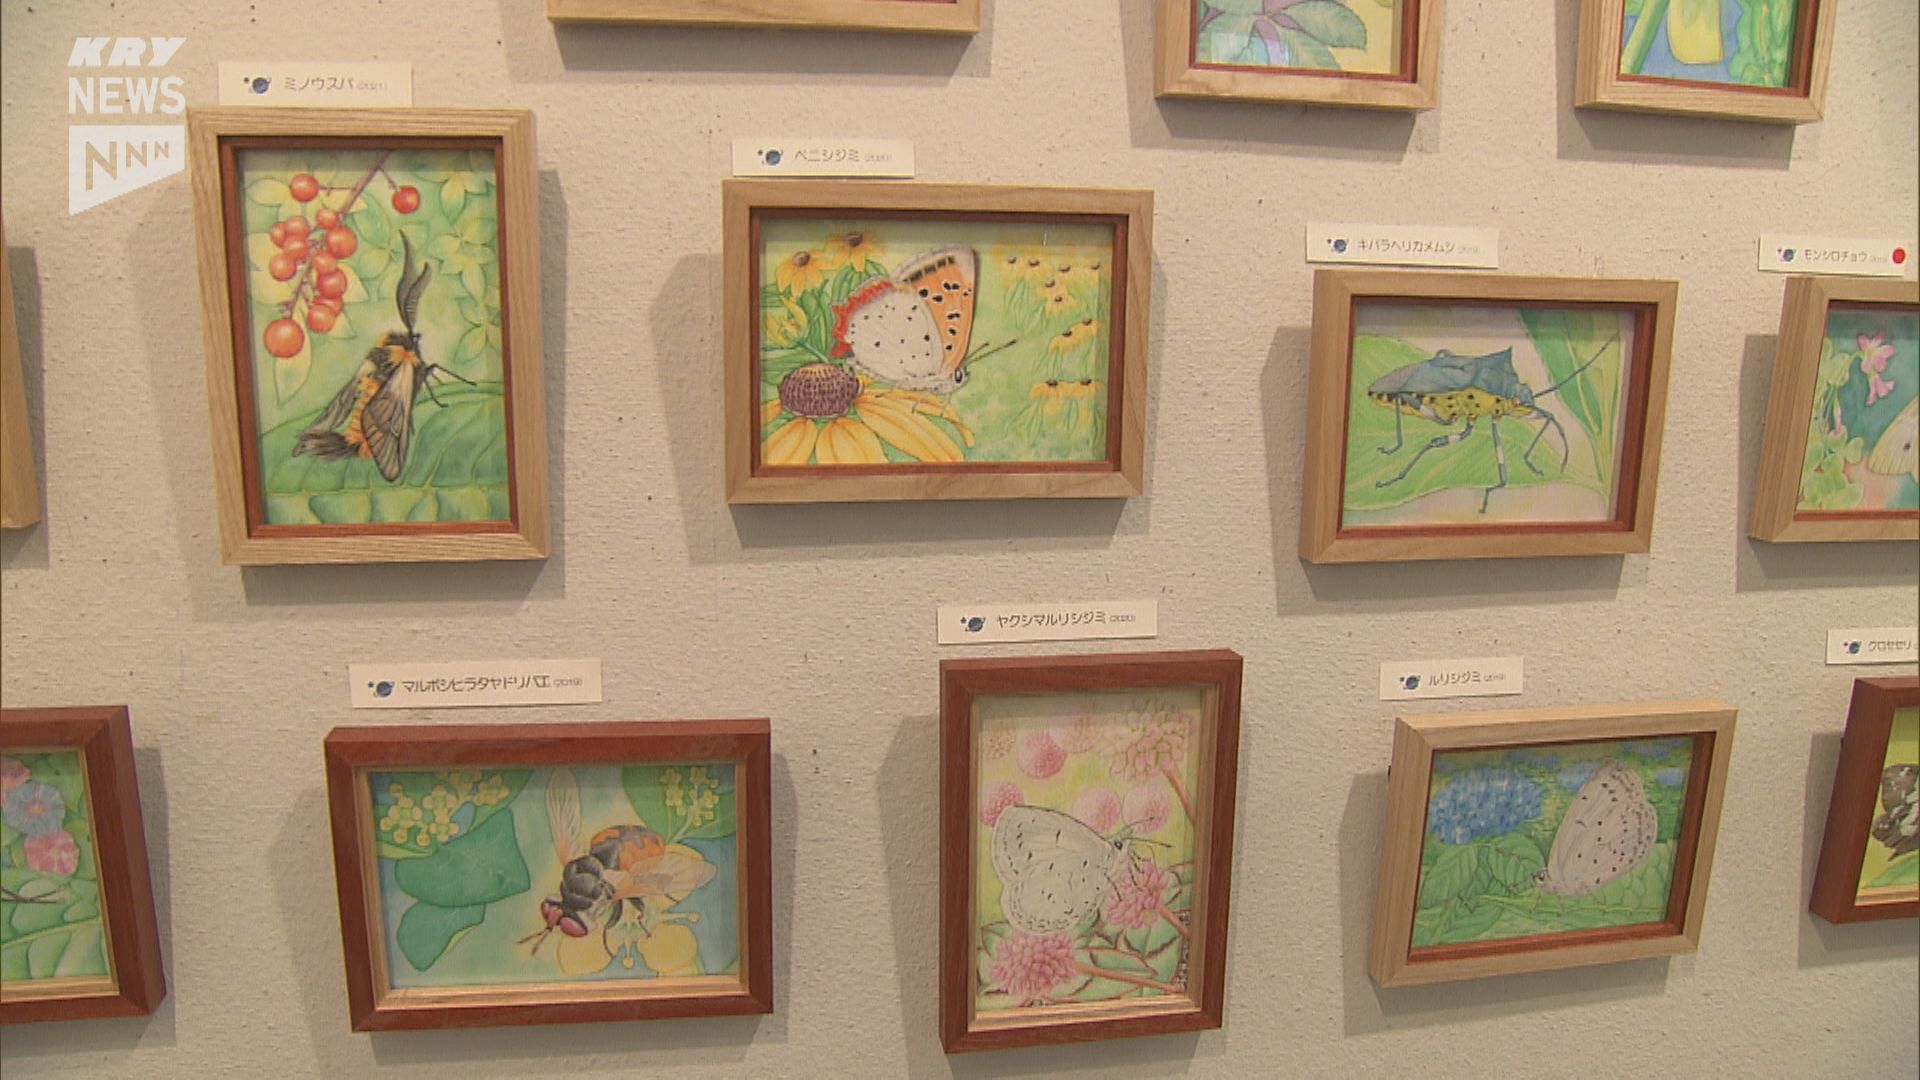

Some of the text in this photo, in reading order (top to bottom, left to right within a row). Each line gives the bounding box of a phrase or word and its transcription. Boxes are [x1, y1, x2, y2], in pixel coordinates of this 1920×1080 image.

[1804, 249, 1868, 263] モンシロチョウ
[998, 611, 1106, 629] ヤクシマルリシジミ
[1429, 671, 1481, 686] ルリシジミ
